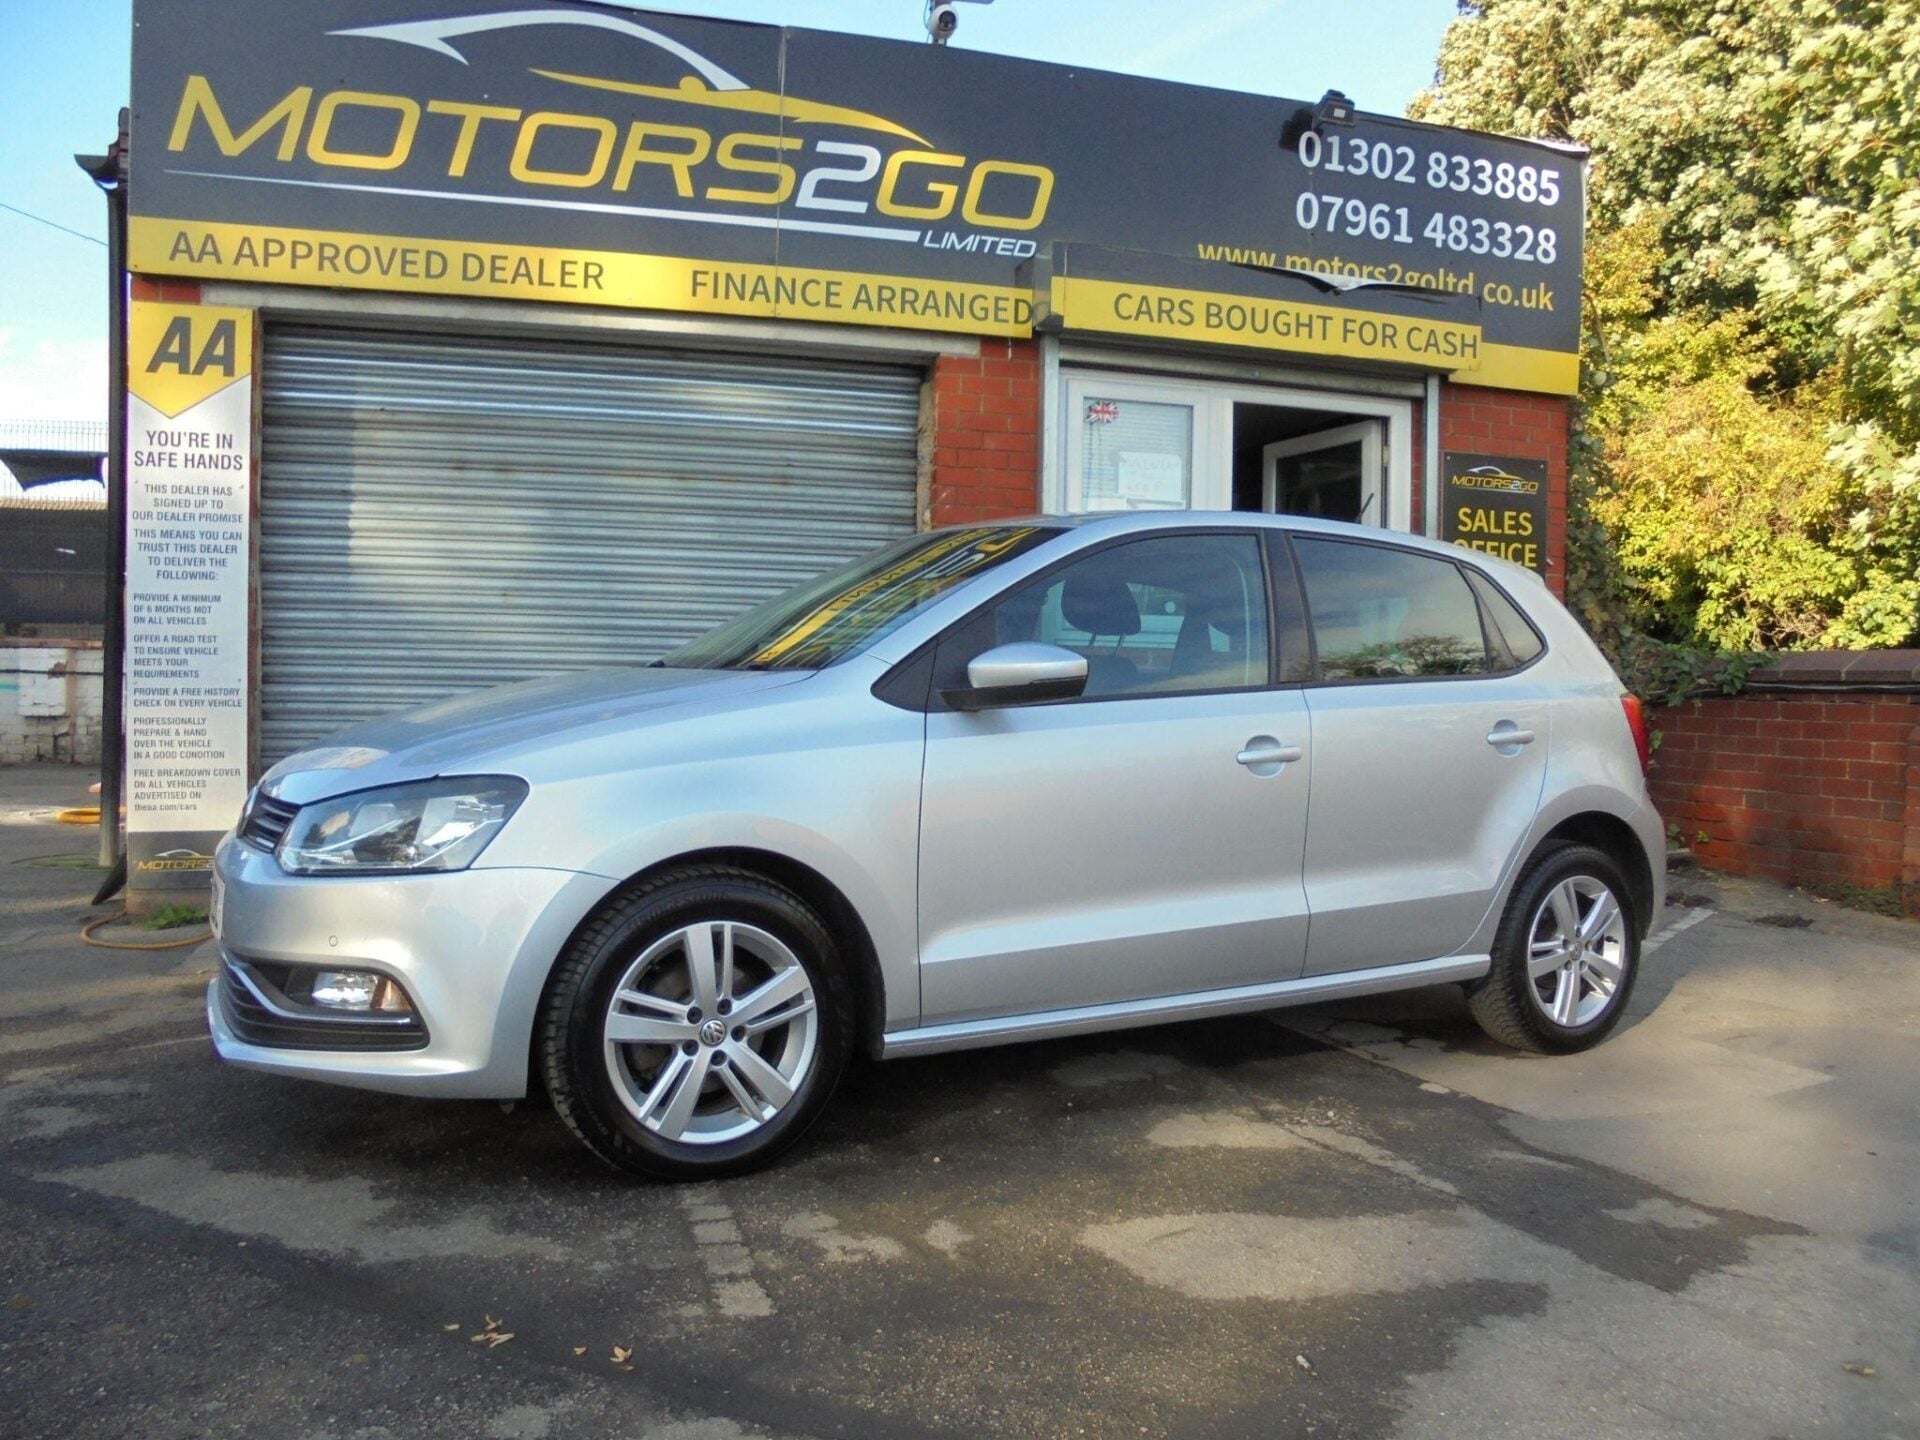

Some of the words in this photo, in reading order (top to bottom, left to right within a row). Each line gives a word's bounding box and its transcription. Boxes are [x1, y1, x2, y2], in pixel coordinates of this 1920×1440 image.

[168, 74, 1055, 231] MOTORS2GO
[1299, 130, 1415, 184] 01302
[1426, 151, 1560, 206] 833885
[1296, 191, 1413, 245] 07961
[1424, 211, 1557, 264] 483328
[923, 229, 1037, 258] LIMITED
[169, 230, 223, 265] AA
[233, 236, 449, 281] APPROVED
[461, 252, 605, 291] DEALER
[690, 269, 843, 309] FINANCE
[852, 283, 1033, 326] ARRANGED
[1114, 293, 1195, 327] CARS
[1205, 302, 1333, 342] BOUGHT
[1342, 317, 1397, 350] FOR
[1406, 326, 1479, 360] CASH
[145, 316, 236, 378] AA
[146, 430, 211, 449] YOU'RE
[216, 433, 233, 450] IN
[134, 450, 178, 468] SAFE
[184, 453, 244, 471] HANDS
[1451, 475, 1539, 492] MOTORS2GO
[144, 483, 167, 494] THIS
[171, 485, 210, 496] DEALER
[213, 486, 233, 497] HAS
[153, 497, 191, 508] SIGNED
[194, 498, 208, 509] UP
[211, 499, 224, 510] TO
[132, 510, 153, 521] OUR
[156, 511, 196, 523] DEALER
[198, 512, 244, 524] PROMISE
[1457, 507, 1533, 537] SALES
[133, 528, 157, 539] THIS
[160, 529, 196, 540] MEANS
[199, 530, 219, 541] YOU
[222, 531, 243, 542] CAN
[137, 542, 170, 553] TRUST
[174, 543, 196, 554] THIS
[200, 544, 239, 555] DEALER
[148, 556, 161, 567] TO
[164, 556, 206, 567] DELIVER
[209, 557, 228, 568] THE
[133, 593, 170, 602] PROVIDE
[173, 594, 179, 602] A
[181, 594, 222, 603] MINIMUM
[133, 605, 144, 613] OF
[155, 605, 192, 614] MONTHS
[194, 606, 212, 615] MOT
[133, 616, 146, 624] ON
[148, 616, 163, 625] ALL
[166, 617, 207, 626] VEHICLES
[133, 634, 161, 643] OFFER
[163, 635, 170, 643] A
[172, 635, 195, 644] ROAD
[197, 635, 217, 644] TEST
[133, 646, 145, 655] TO
[147, 646, 181, 655] ENSURE
[183, 647, 219, 656] VEHICLE
[134, 658, 163, 667] MEETS
[165, 658, 189, 667] YOUR
[133, 669, 200, 679] REQUIREMENTS
[133, 687, 170, 696] PROVIDE
[173, 688, 179, 696] A
[181, 688, 202, 696] FREE
[204, 688, 240, 696] HISTORY
[133, 699, 162, 708] CHECK
[164, 699, 176, 708] ON
[178, 699, 205, 708] EVERY
[207, 699, 242, 708] VEHICLE
[133, 717, 207, 726] PROFESSIONALLY
[133, 728, 172, 737] PREPARE
[183, 728, 207, 737] HAND
[133, 739, 157, 748] OVER
[159, 739, 175, 748] THE
[177, 739, 212, 748] VEHICLE
[133, 751, 143, 759] IN
[144, 751, 151, 759] A
[153, 751, 177, 760] GOOD
[179, 750, 225, 759] CONDITION
[133, 768, 154, 777] FREE
[157, 768, 211, 777] BREAKDOWN
[213, 768, 241, 777] COVER
[134, 780, 146, 788] ON
[148, 780, 163, 788] ALL
[167, 780, 207, 788] VEHICLES
[134, 791, 187, 800] ADVERTISED
[189, 790, 202, 799] ON
